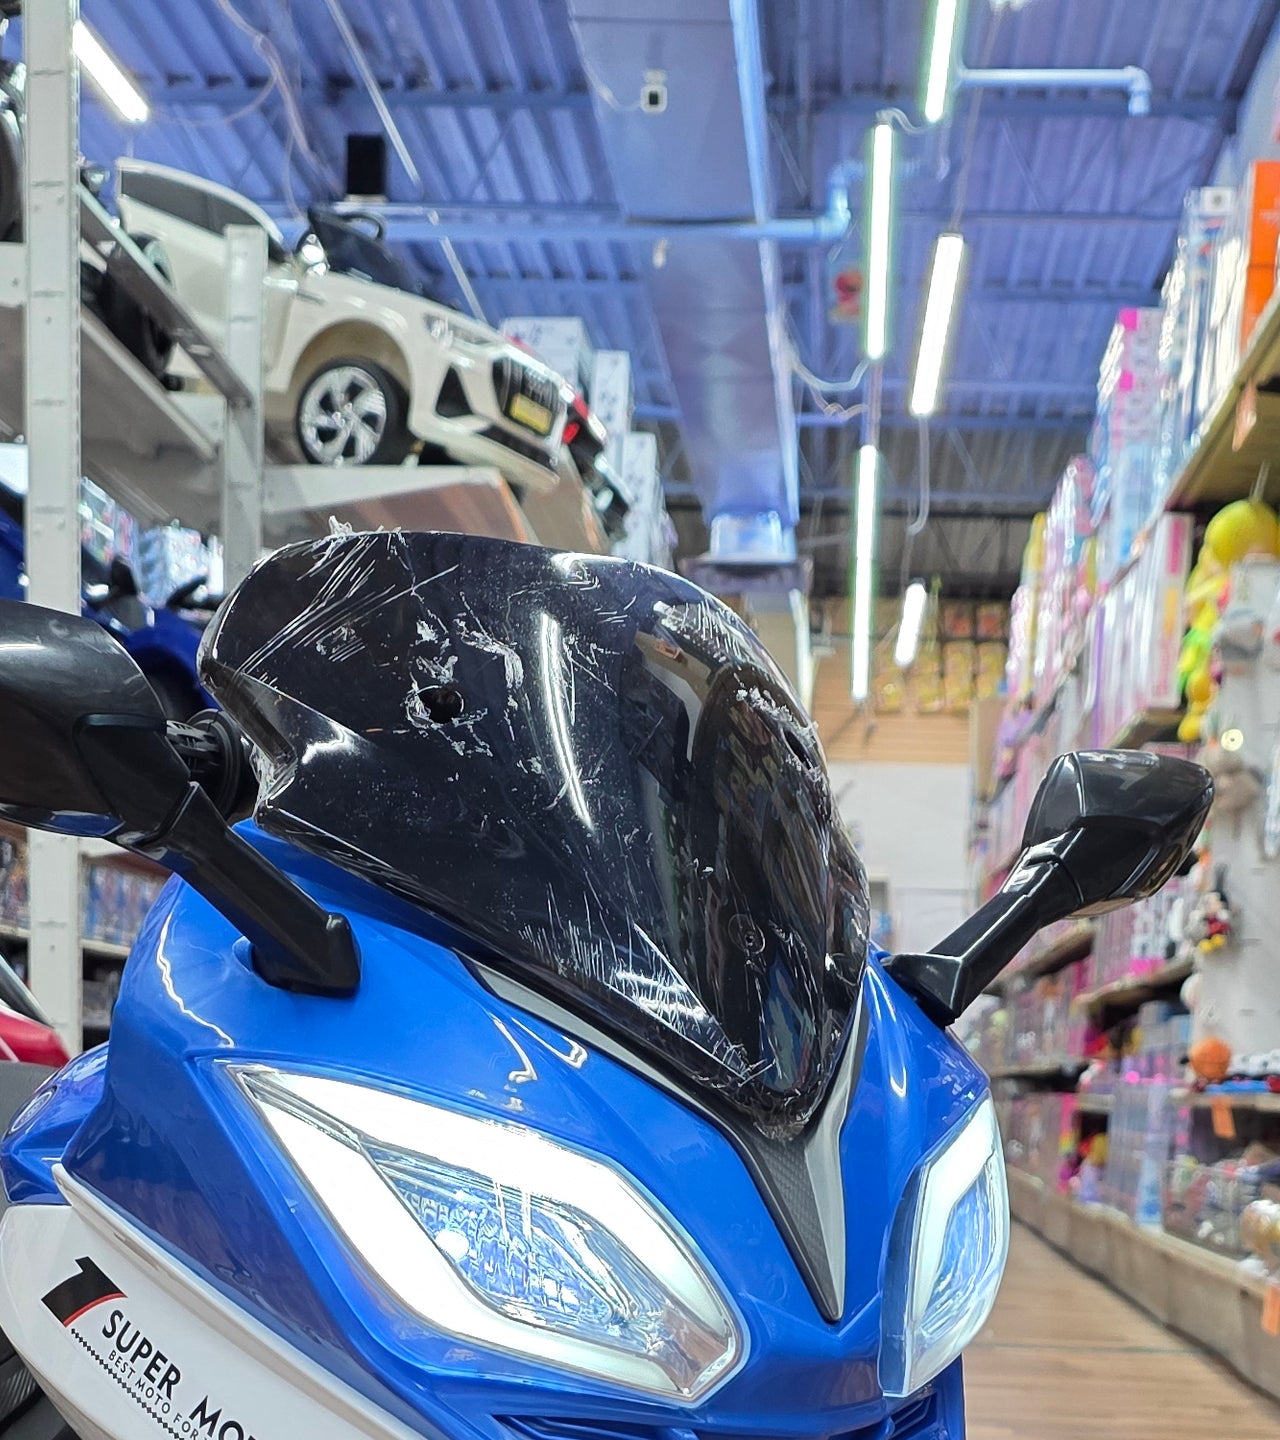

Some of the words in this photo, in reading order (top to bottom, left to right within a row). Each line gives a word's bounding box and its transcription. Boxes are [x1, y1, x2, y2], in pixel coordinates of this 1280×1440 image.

[102, 1309, 182, 1400] SUPER
[108, 1350, 136, 1379] BEST
[135, 1379, 170, 1414] MOTO
